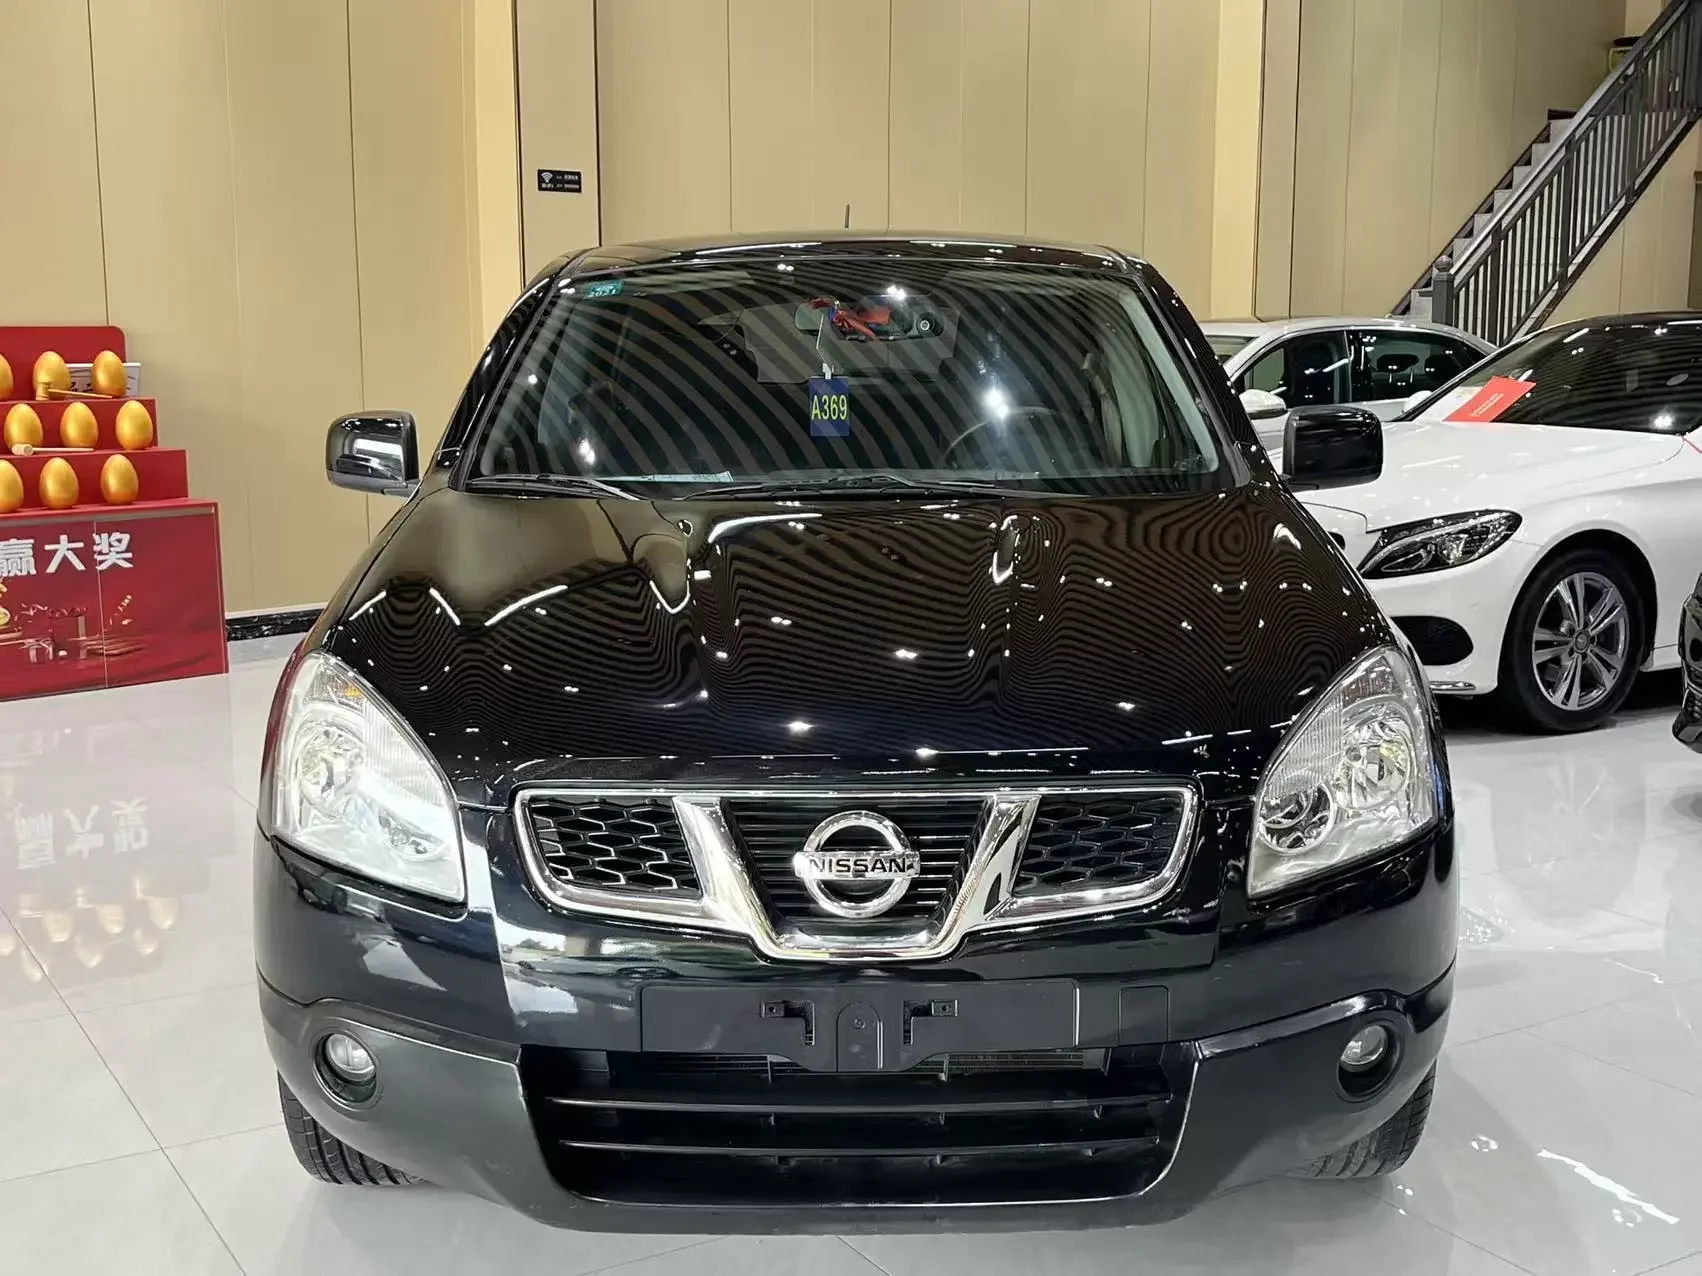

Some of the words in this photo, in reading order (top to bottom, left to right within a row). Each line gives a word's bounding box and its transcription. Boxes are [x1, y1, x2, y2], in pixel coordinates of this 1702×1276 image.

[811, 394, 848, 420] A369
[0, 531, 134, 577] 赢大奖
[809, 858, 906, 874] NISSAN
